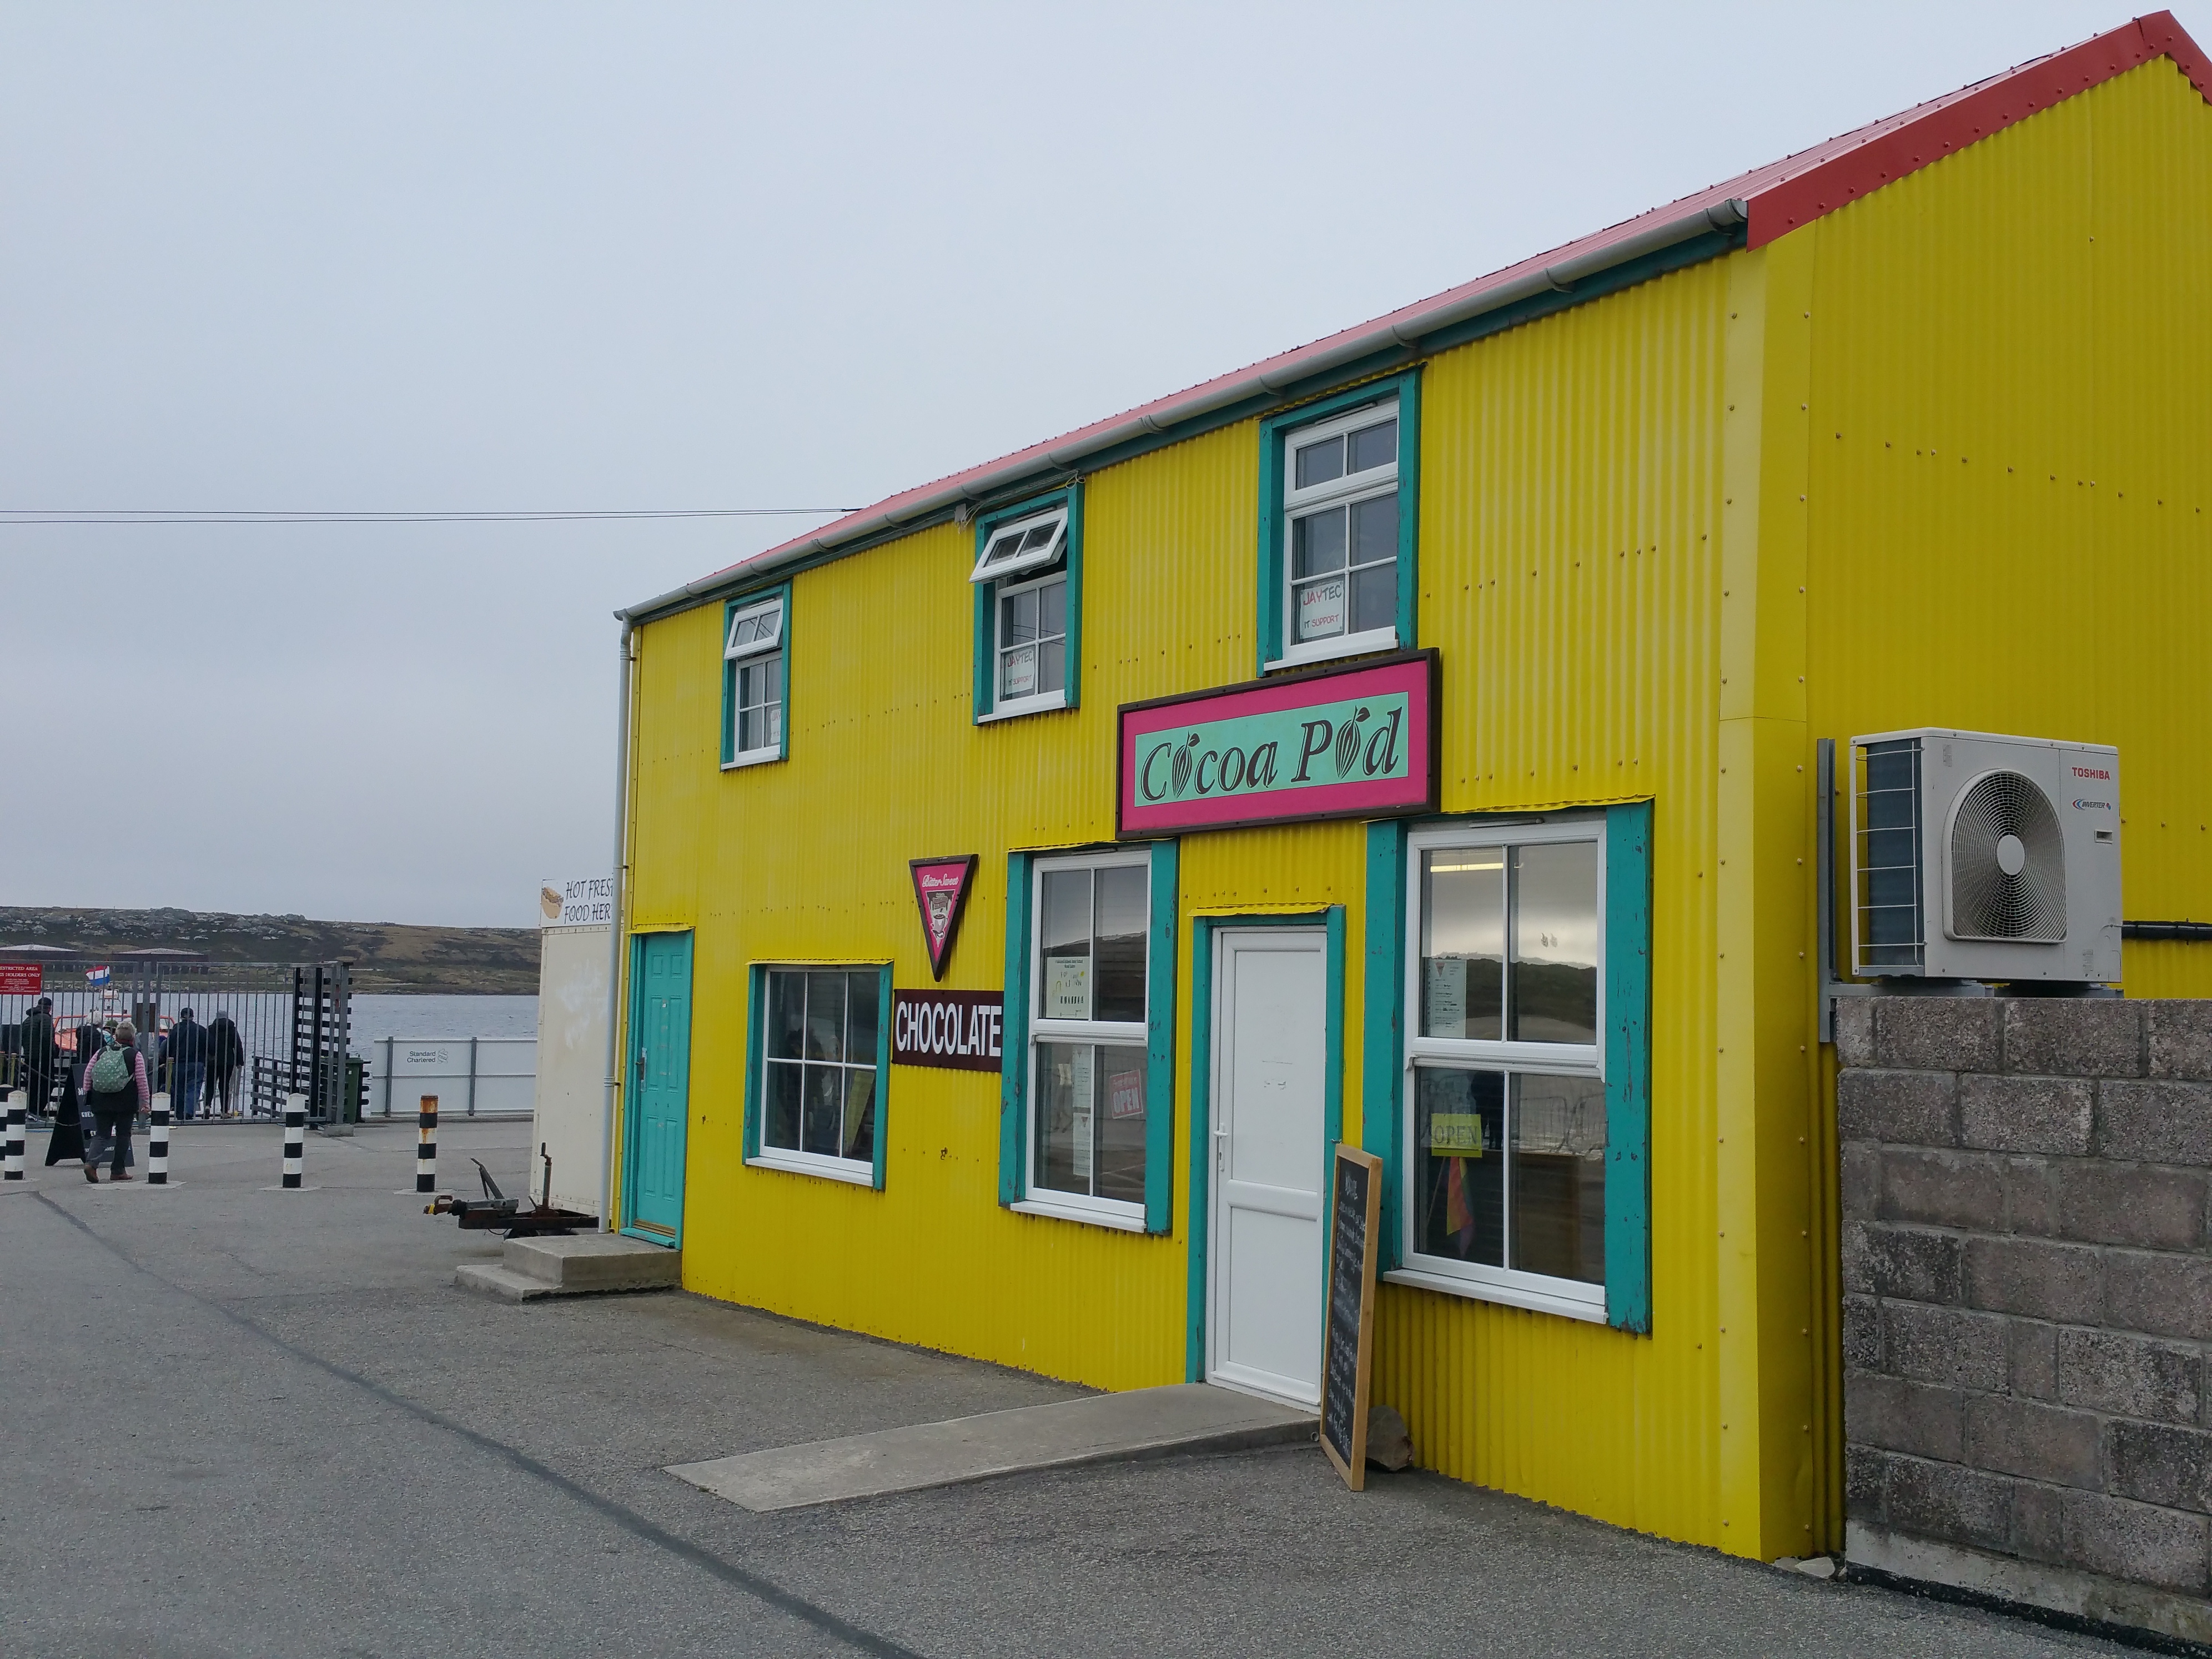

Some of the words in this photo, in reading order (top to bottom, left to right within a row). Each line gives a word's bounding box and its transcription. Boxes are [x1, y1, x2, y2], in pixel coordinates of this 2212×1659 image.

[1303, 585, 1342, 606] JAYTEC
[1304, 620, 1310, 629] IT
[1311, 614, 1339, 627] SUPPORT
[1007, 651, 1033, 667] JAYTEC
[1013, 675, 1032, 685] SUPPORT
[1141, 731, 1278, 801] Cocoa
[1291, 706, 1402, 783] Pod
[2072, 767, 2110, 781] TOSHIBA
[566, 879, 587, 900] HOT
[922, 874, 942, 888] Bitter
[564, 904, 590, 924] FOOD
[592, 902, 612, 922] HER
[896, 1001, 1002, 1057] CHOCOLATE
[1113, 1087, 1140, 1114] OPEN
[1435, 1125, 1478, 1145] OPEN
